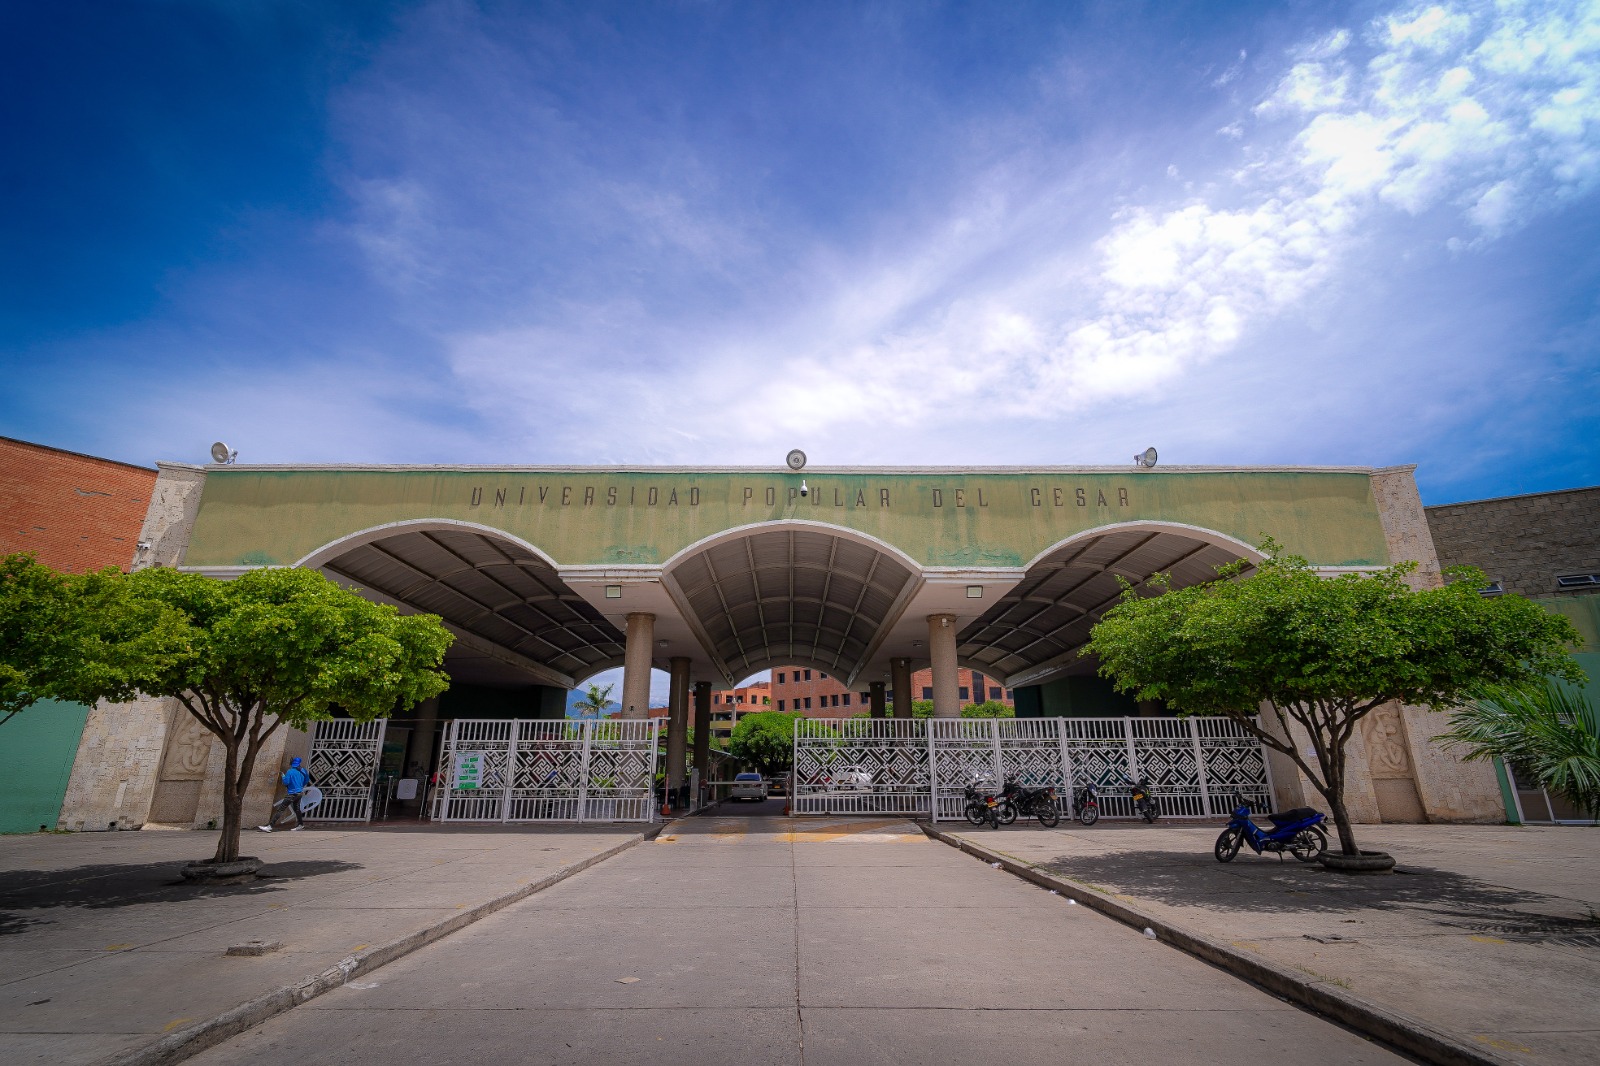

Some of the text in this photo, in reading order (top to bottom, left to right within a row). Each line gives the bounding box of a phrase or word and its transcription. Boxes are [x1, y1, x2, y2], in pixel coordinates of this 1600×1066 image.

[471, 486, 1130, 507] UNIVERSIDAD POPULAR DEL CESAR
